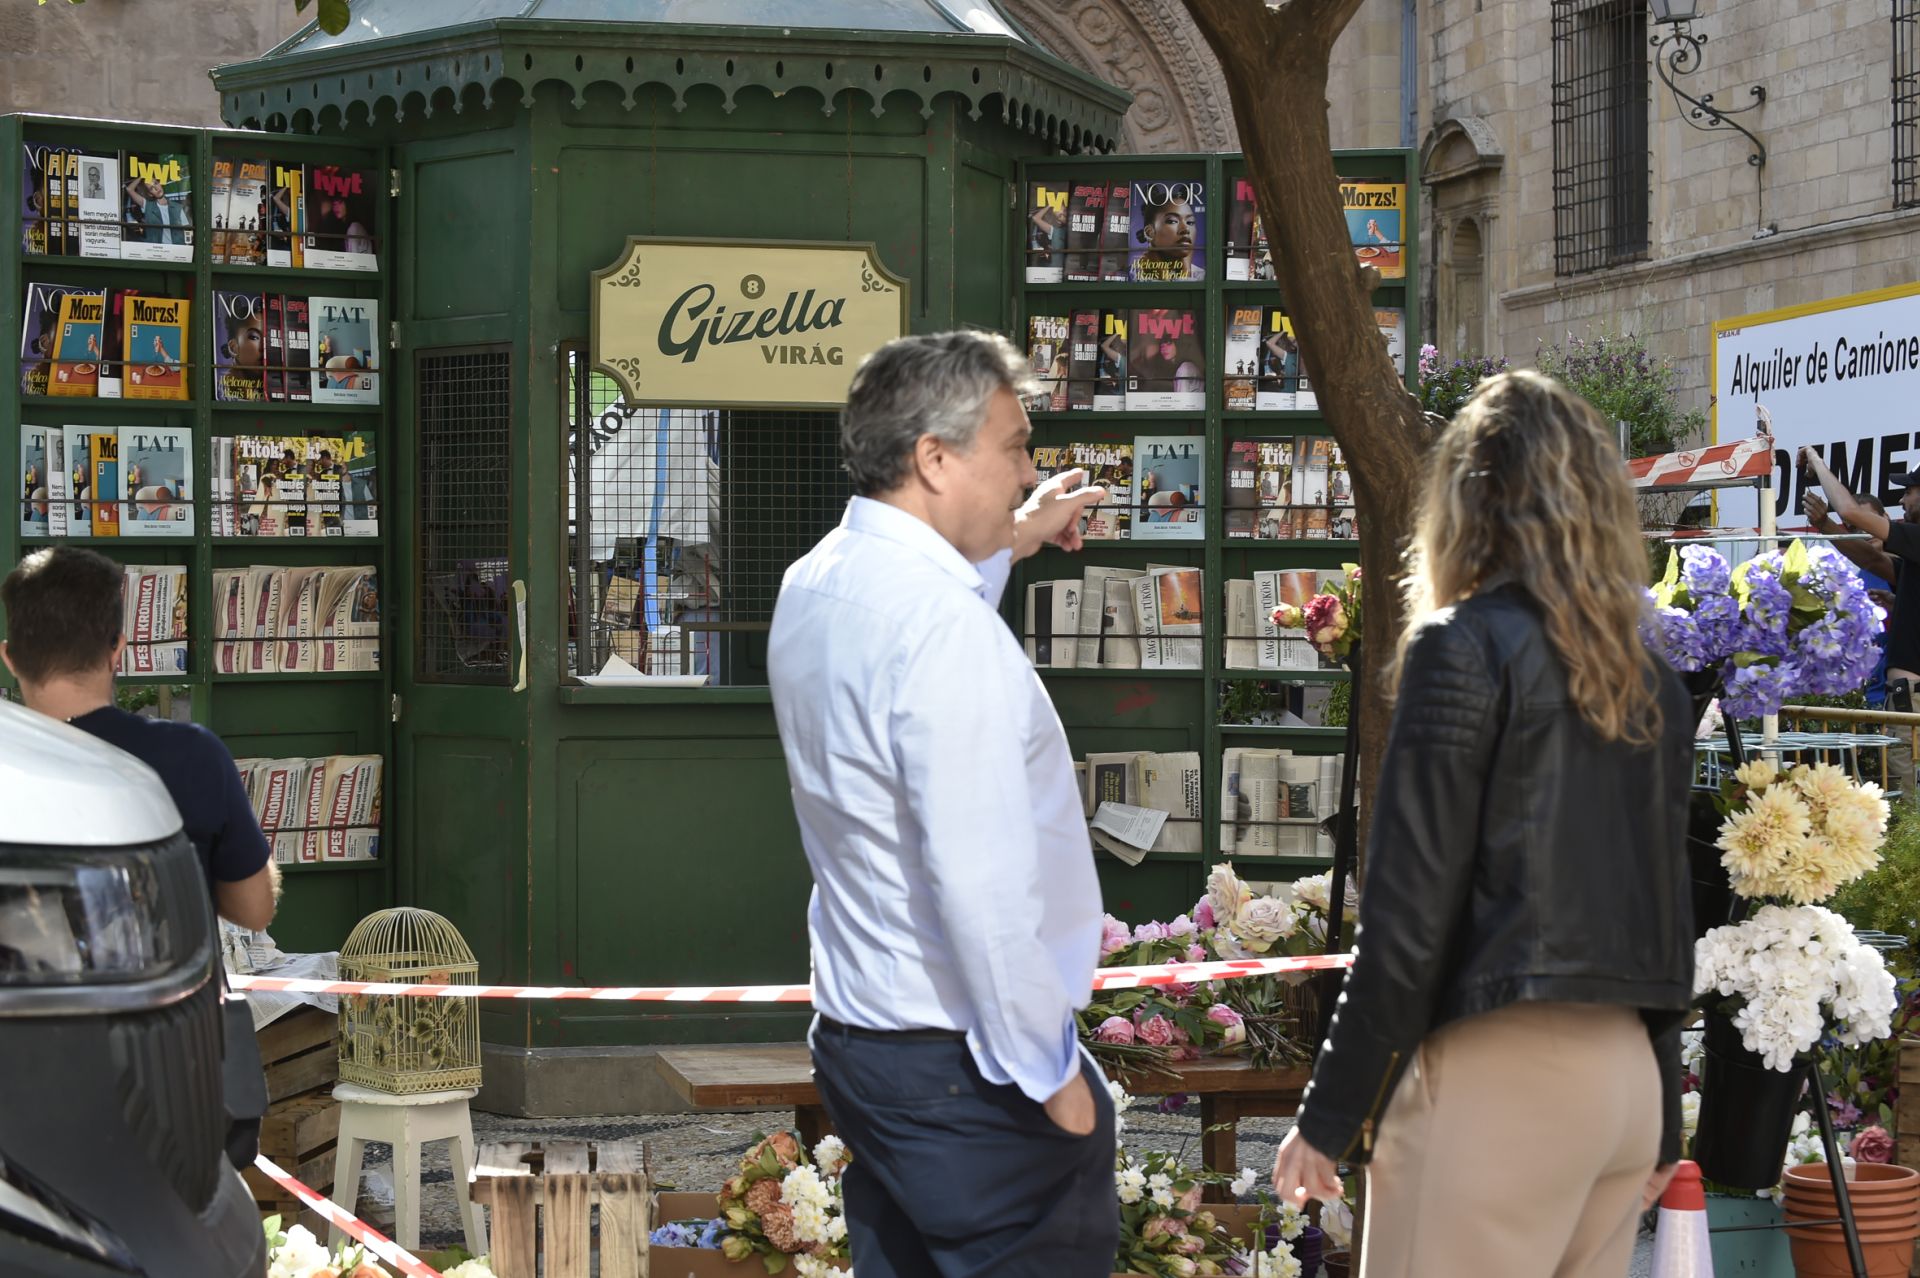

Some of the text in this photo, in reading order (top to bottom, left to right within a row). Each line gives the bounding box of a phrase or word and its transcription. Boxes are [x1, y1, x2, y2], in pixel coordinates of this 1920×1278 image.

[1134, 182, 1203, 206] NOOR
[1342, 186, 1396, 206] Morzs!
[1132, 258, 1172, 270] Welcome
[133, 300, 179, 323] Morzs!
[323, 305, 365, 324] TAT
[658, 283, 846, 364] Gizella
[760, 342, 844, 366] VIRÁG
[1731, 331, 1920, 403] Alquiler de Camione
[133, 435, 179, 452] TAT
[239, 440, 286, 460] Titok!
[1148, 444, 1194, 460] TAT
[1073, 446, 1122, 467] Titok!
[266, 617, 276, 662] INSDER
[1265, 626, 1274, 660] MAGAR
